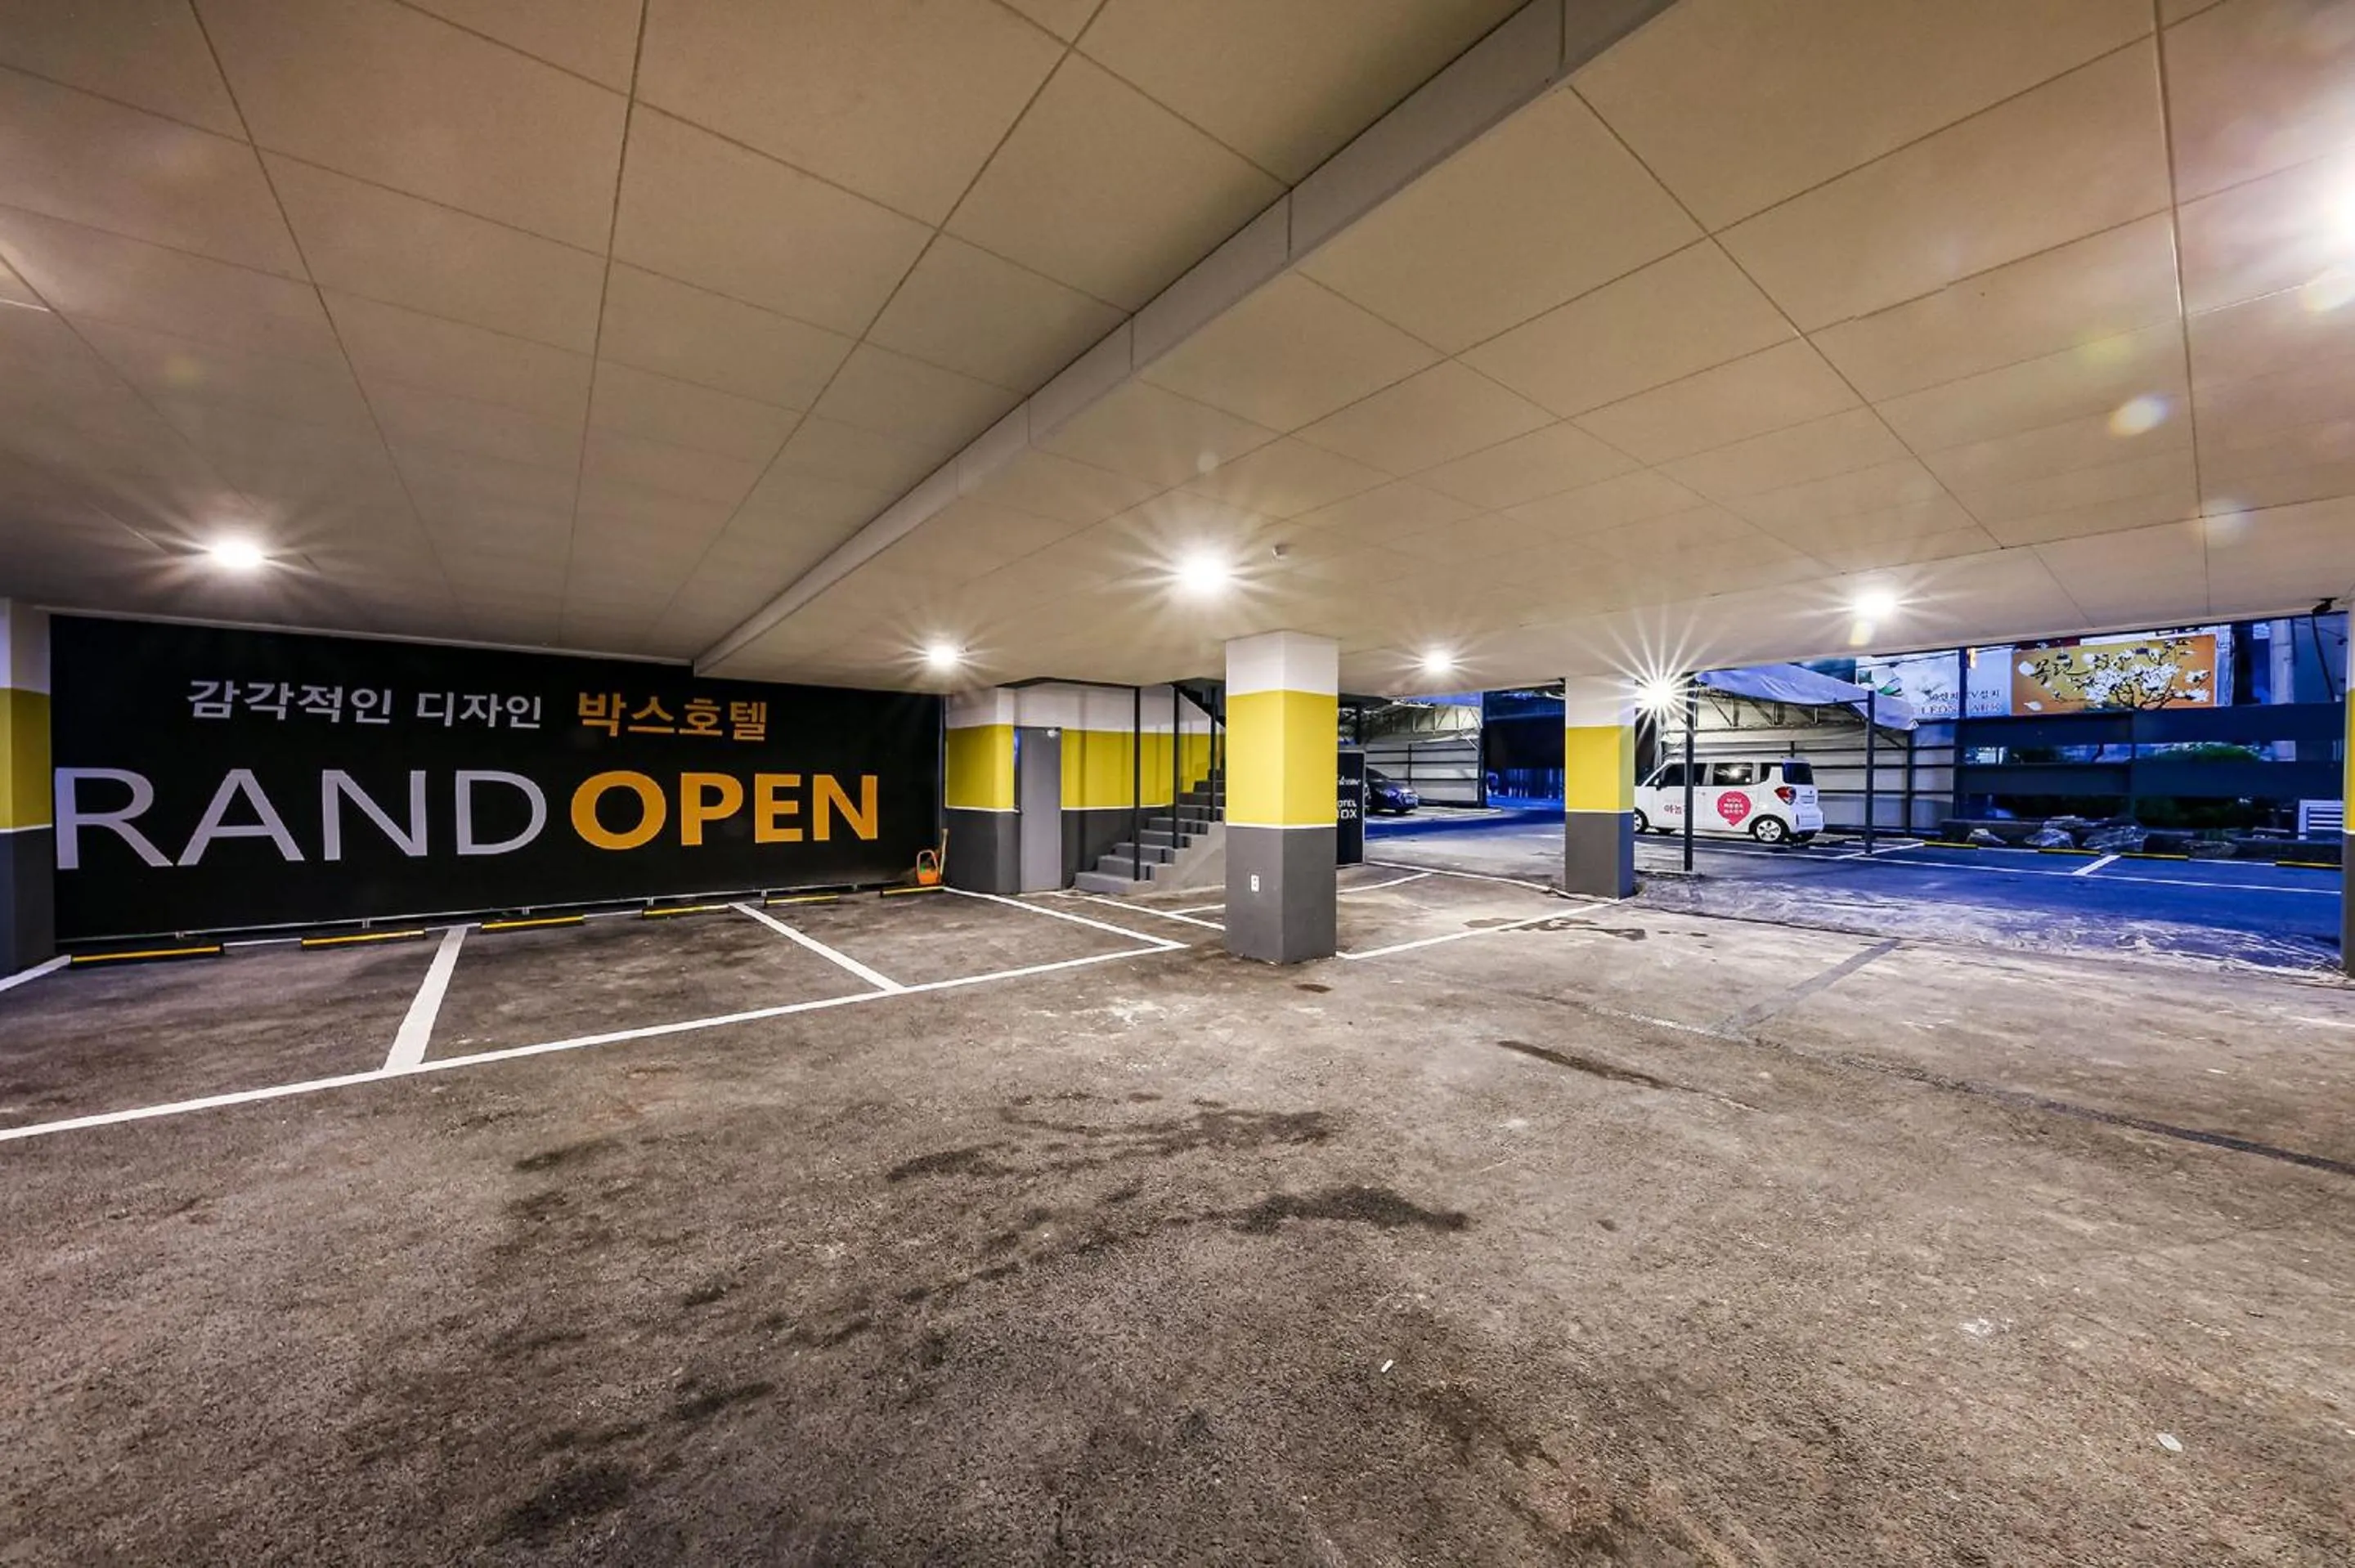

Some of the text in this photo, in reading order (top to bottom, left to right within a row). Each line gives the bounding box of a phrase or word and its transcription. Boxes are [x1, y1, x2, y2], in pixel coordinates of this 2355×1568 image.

[186, 682, 765, 740] 감각적인 디자인 박스호텔
[54, 768, 877, 869] RAND OPEN
